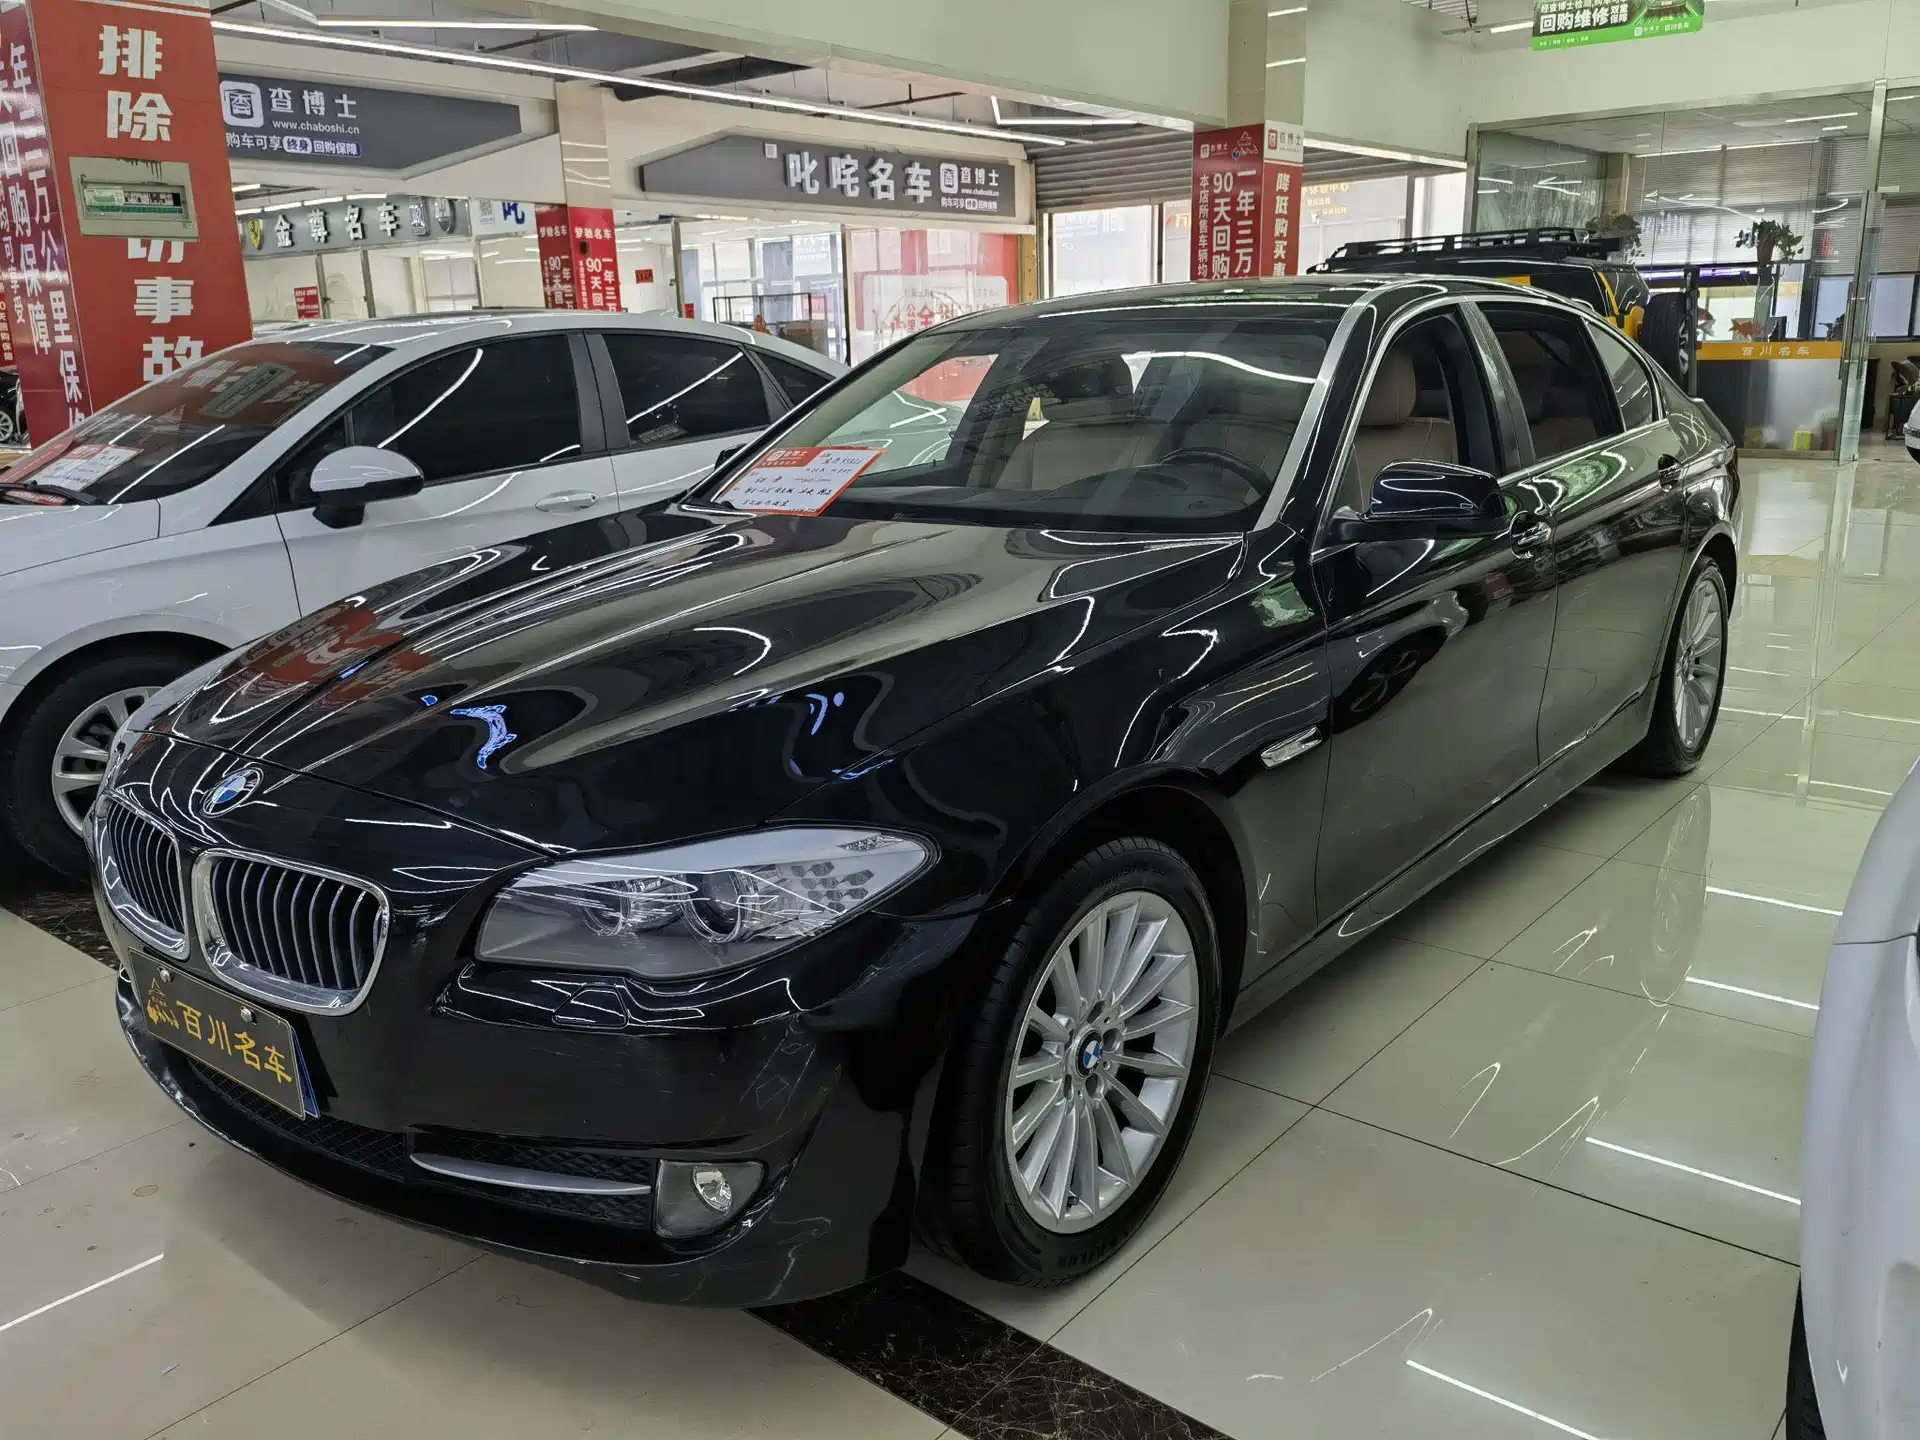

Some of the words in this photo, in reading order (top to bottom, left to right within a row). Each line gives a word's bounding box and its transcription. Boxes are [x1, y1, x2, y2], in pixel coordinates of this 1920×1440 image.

[1540, 7, 1609, 34] 回购维修
[268, 87, 357, 119] 查博士
[272, 120, 360, 135] www.chaboshi.cn
[785, 151, 932, 203] 叱咤名车
[98, 24, 204, 383] 排除事故
[274, 202, 400, 248] 金尊名车
[1211, 171, 1234, 280] 90天回购
[1234, 169, 1257, 275] 一年三万
[176, 1000, 293, 1083] 百川名车
